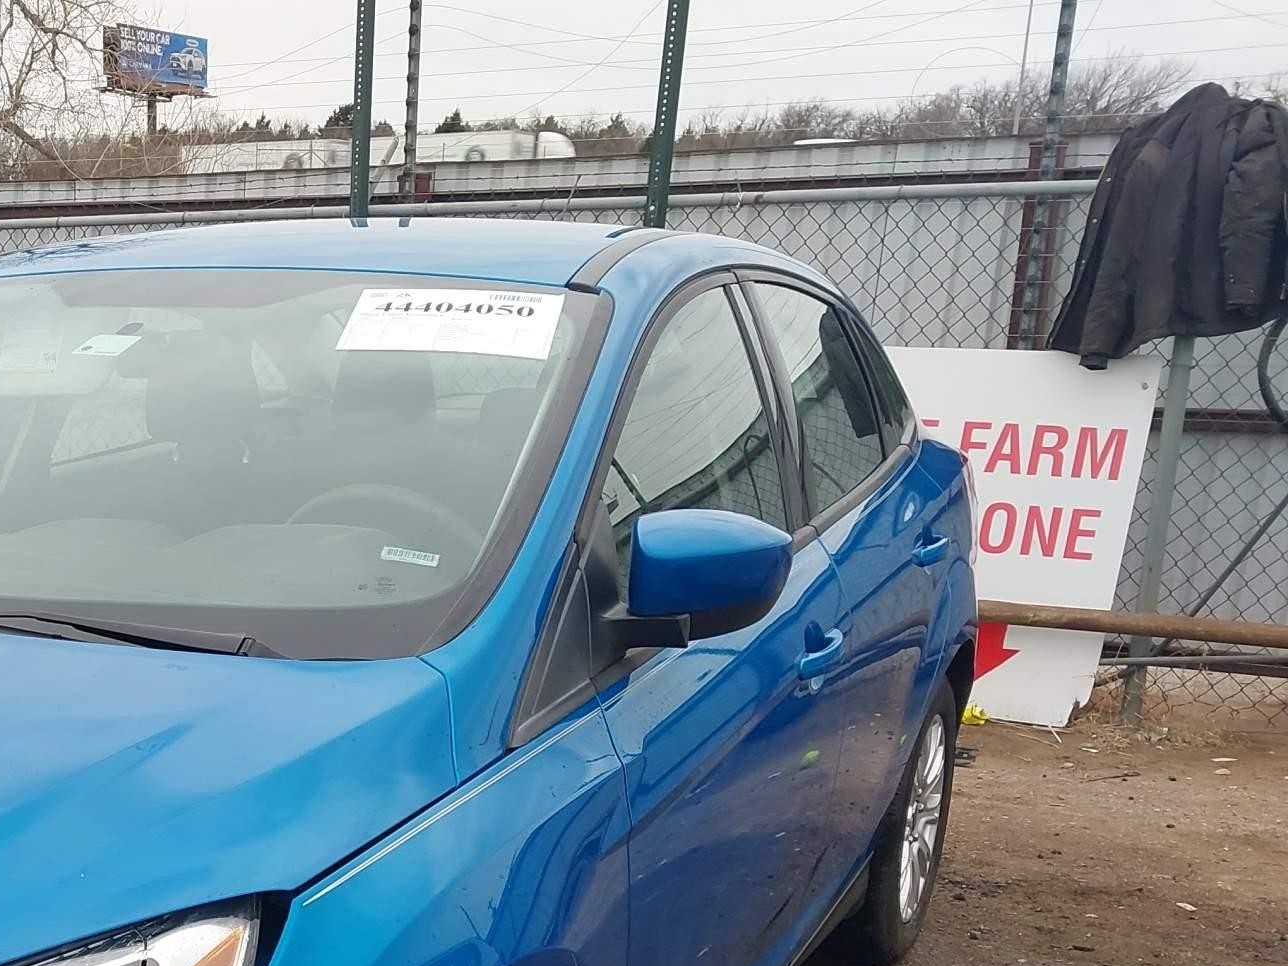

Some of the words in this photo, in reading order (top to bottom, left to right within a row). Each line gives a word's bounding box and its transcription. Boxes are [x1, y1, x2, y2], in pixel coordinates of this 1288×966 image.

[120, 27, 135, 39] SELL
[136, 30, 156, 42] YOUR
[156, 33, 170, 46] CAR
[137, 42, 163, 56] ONLINE
[375, 301, 535, 318] 44404050
[962, 420, 1129, 481] FARM
